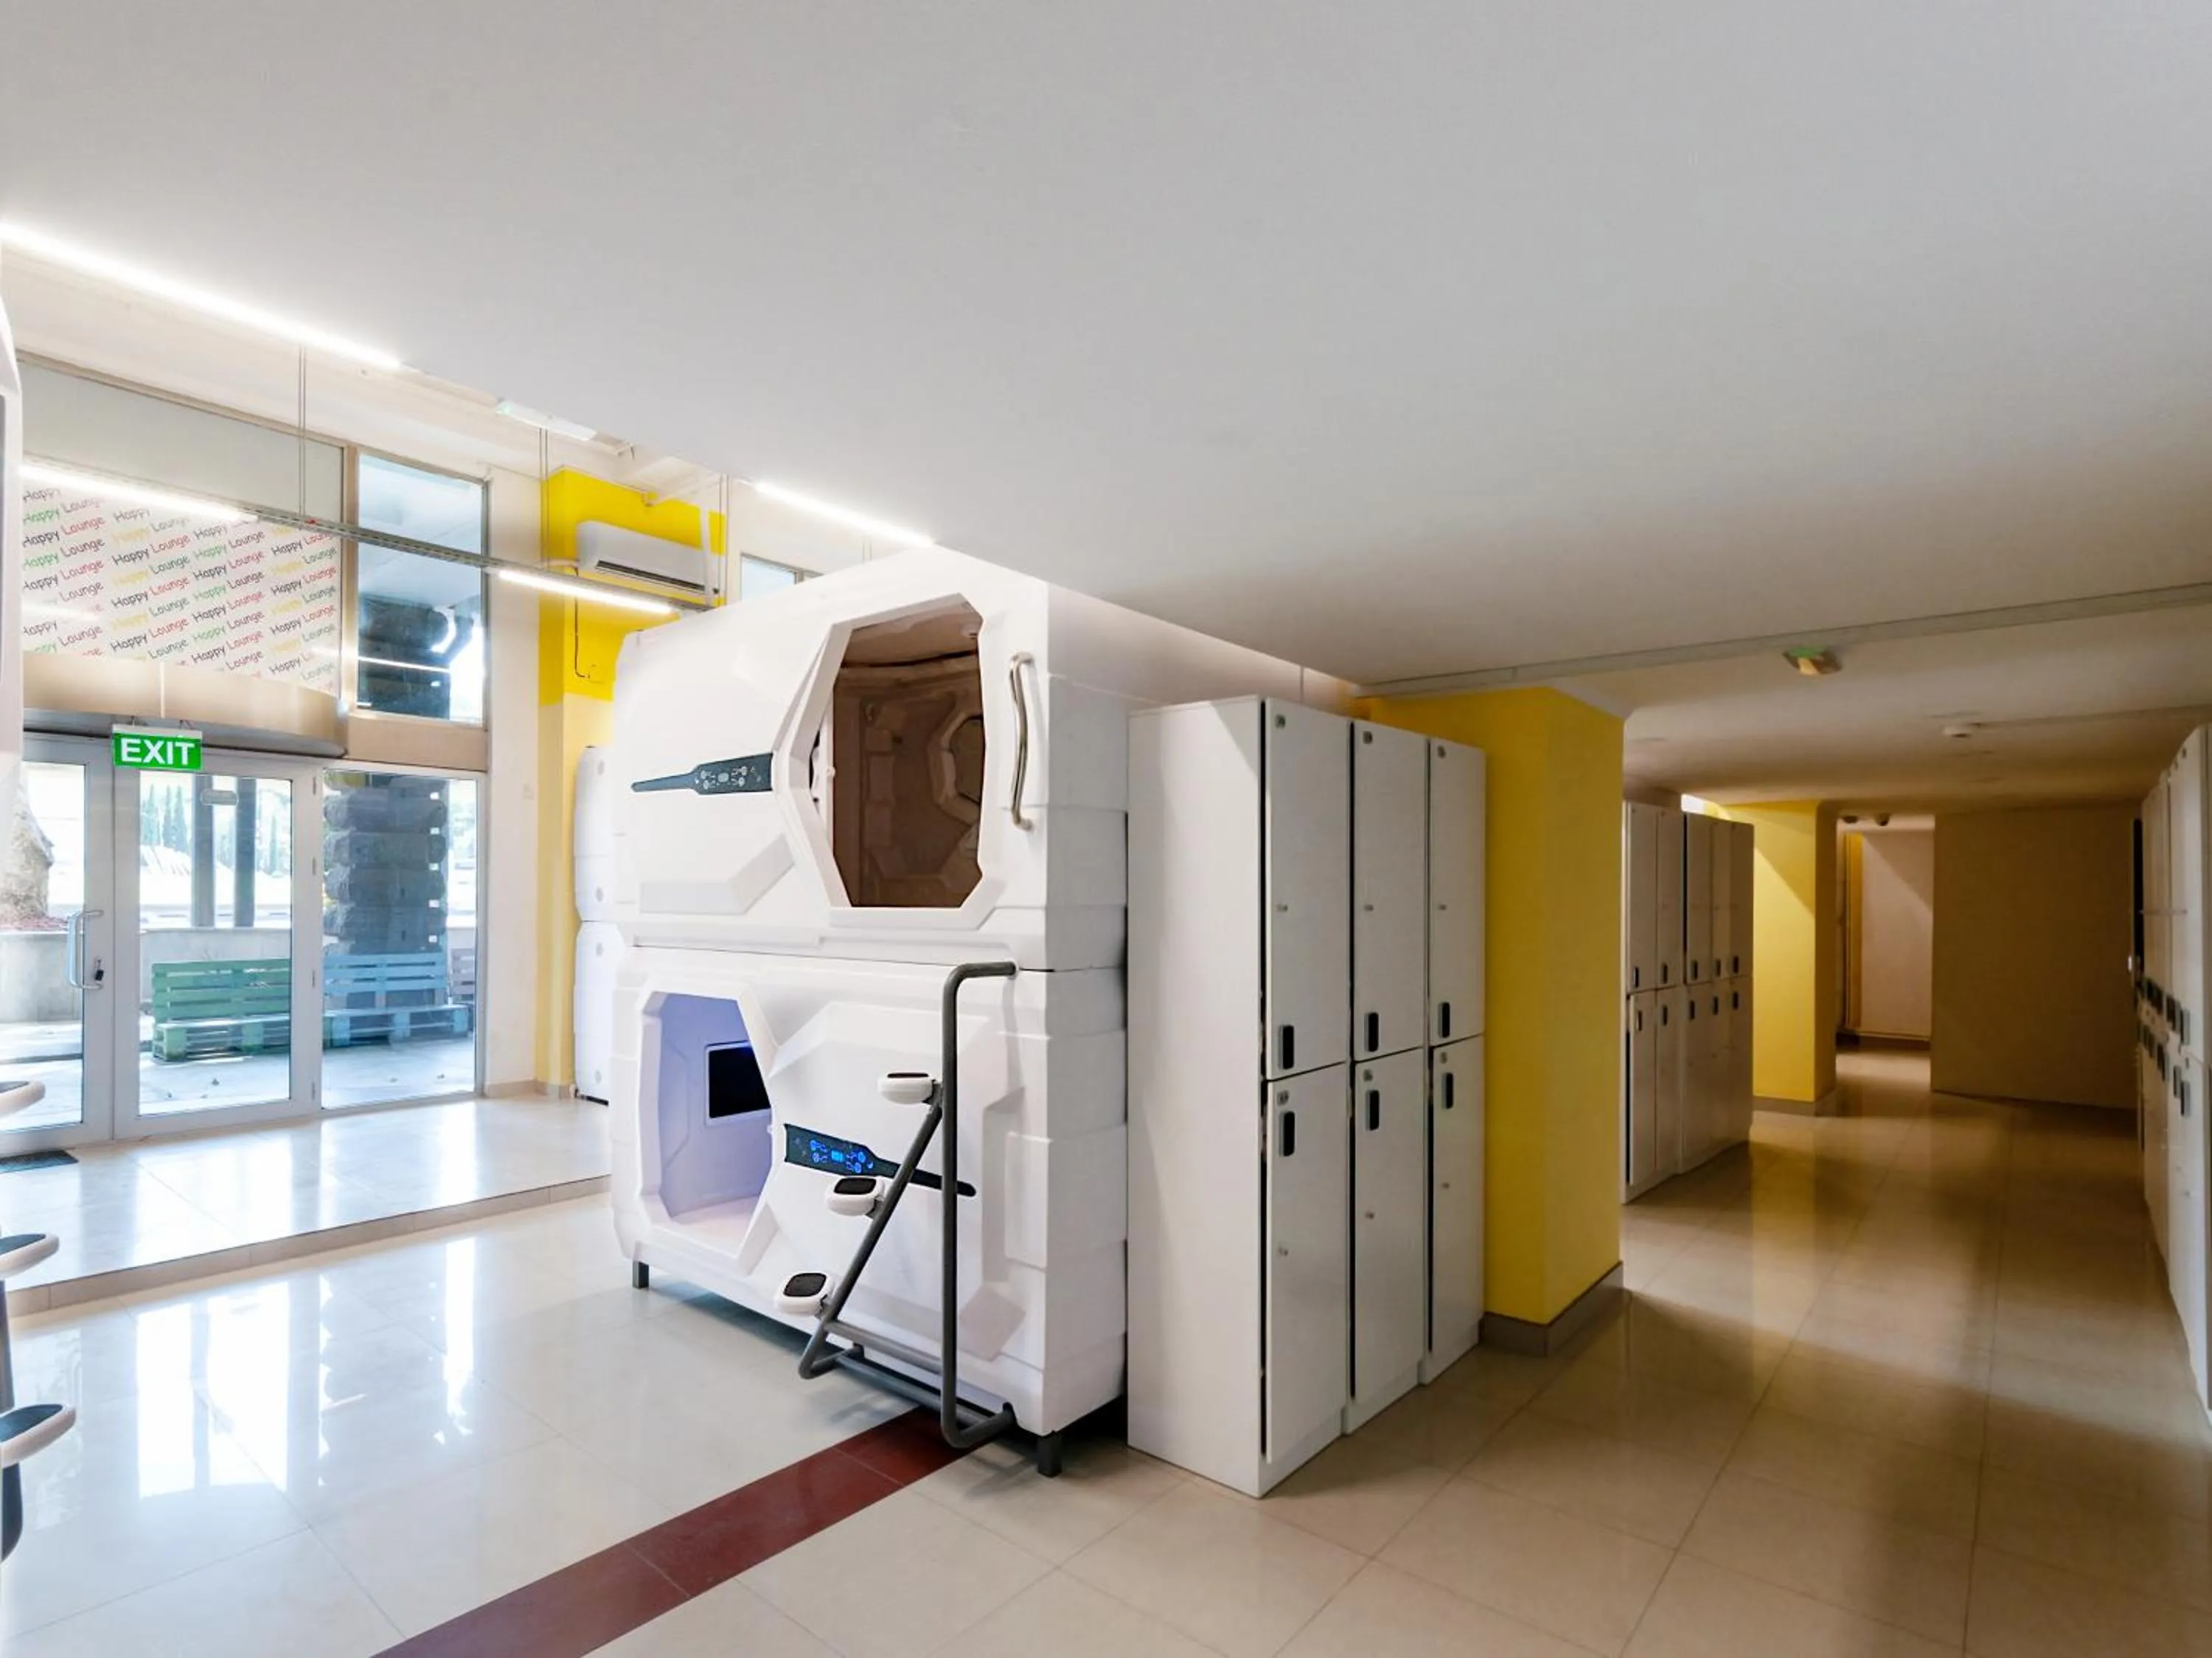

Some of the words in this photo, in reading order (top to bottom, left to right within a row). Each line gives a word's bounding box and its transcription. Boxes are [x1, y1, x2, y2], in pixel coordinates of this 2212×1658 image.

[60, 517, 105, 535] Lounge
[60, 539, 105, 557] Lounge
[228, 531, 265, 549] Lounge
[271, 540, 303, 555] Happy
[111, 548, 150, 566] Happy
[150, 535, 190, 553] Lounge
[302, 546, 337, 564] Lounge
[59, 561, 104, 580] Lounge
[149, 555, 190, 575] Lounge
[192, 564, 227, 580] Happy
[227, 550, 265, 569] Lounge
[226, 572, 265, 589] Lounge
[271, 579, 302, 595] Happy
[302, 565, 337, 583] Lounge
[59, 582, 104, 602] Lounge
[111, 590, 148, 608] Happy
[150, 577, 190, 595] Lounge
[302, 585, 336, 603] Lounge
[149, 597, 189, 617] Lounge
[192, 604, 226, 622] Happy
[226, 592, 265, 610] Lounge
[226, 611, 265, 630] Lounge
[269, 618, 302, 635] Happy
[302, 605, 336, 622] Lounge
[58, 626, 103, 647] Lounge
[110, 632, 147, 652] Happy
[148, 618, 190, 638] Lounge
[147, 639, 189, 659] Lounge
[191, 645, 226, 664] Happy
[226, 631, 264, 650] Lounge
[225, 651, 264, 670] Lounge
[268, 656, 302, 676] Happy
[121, 738, 195, 766] EXIT
